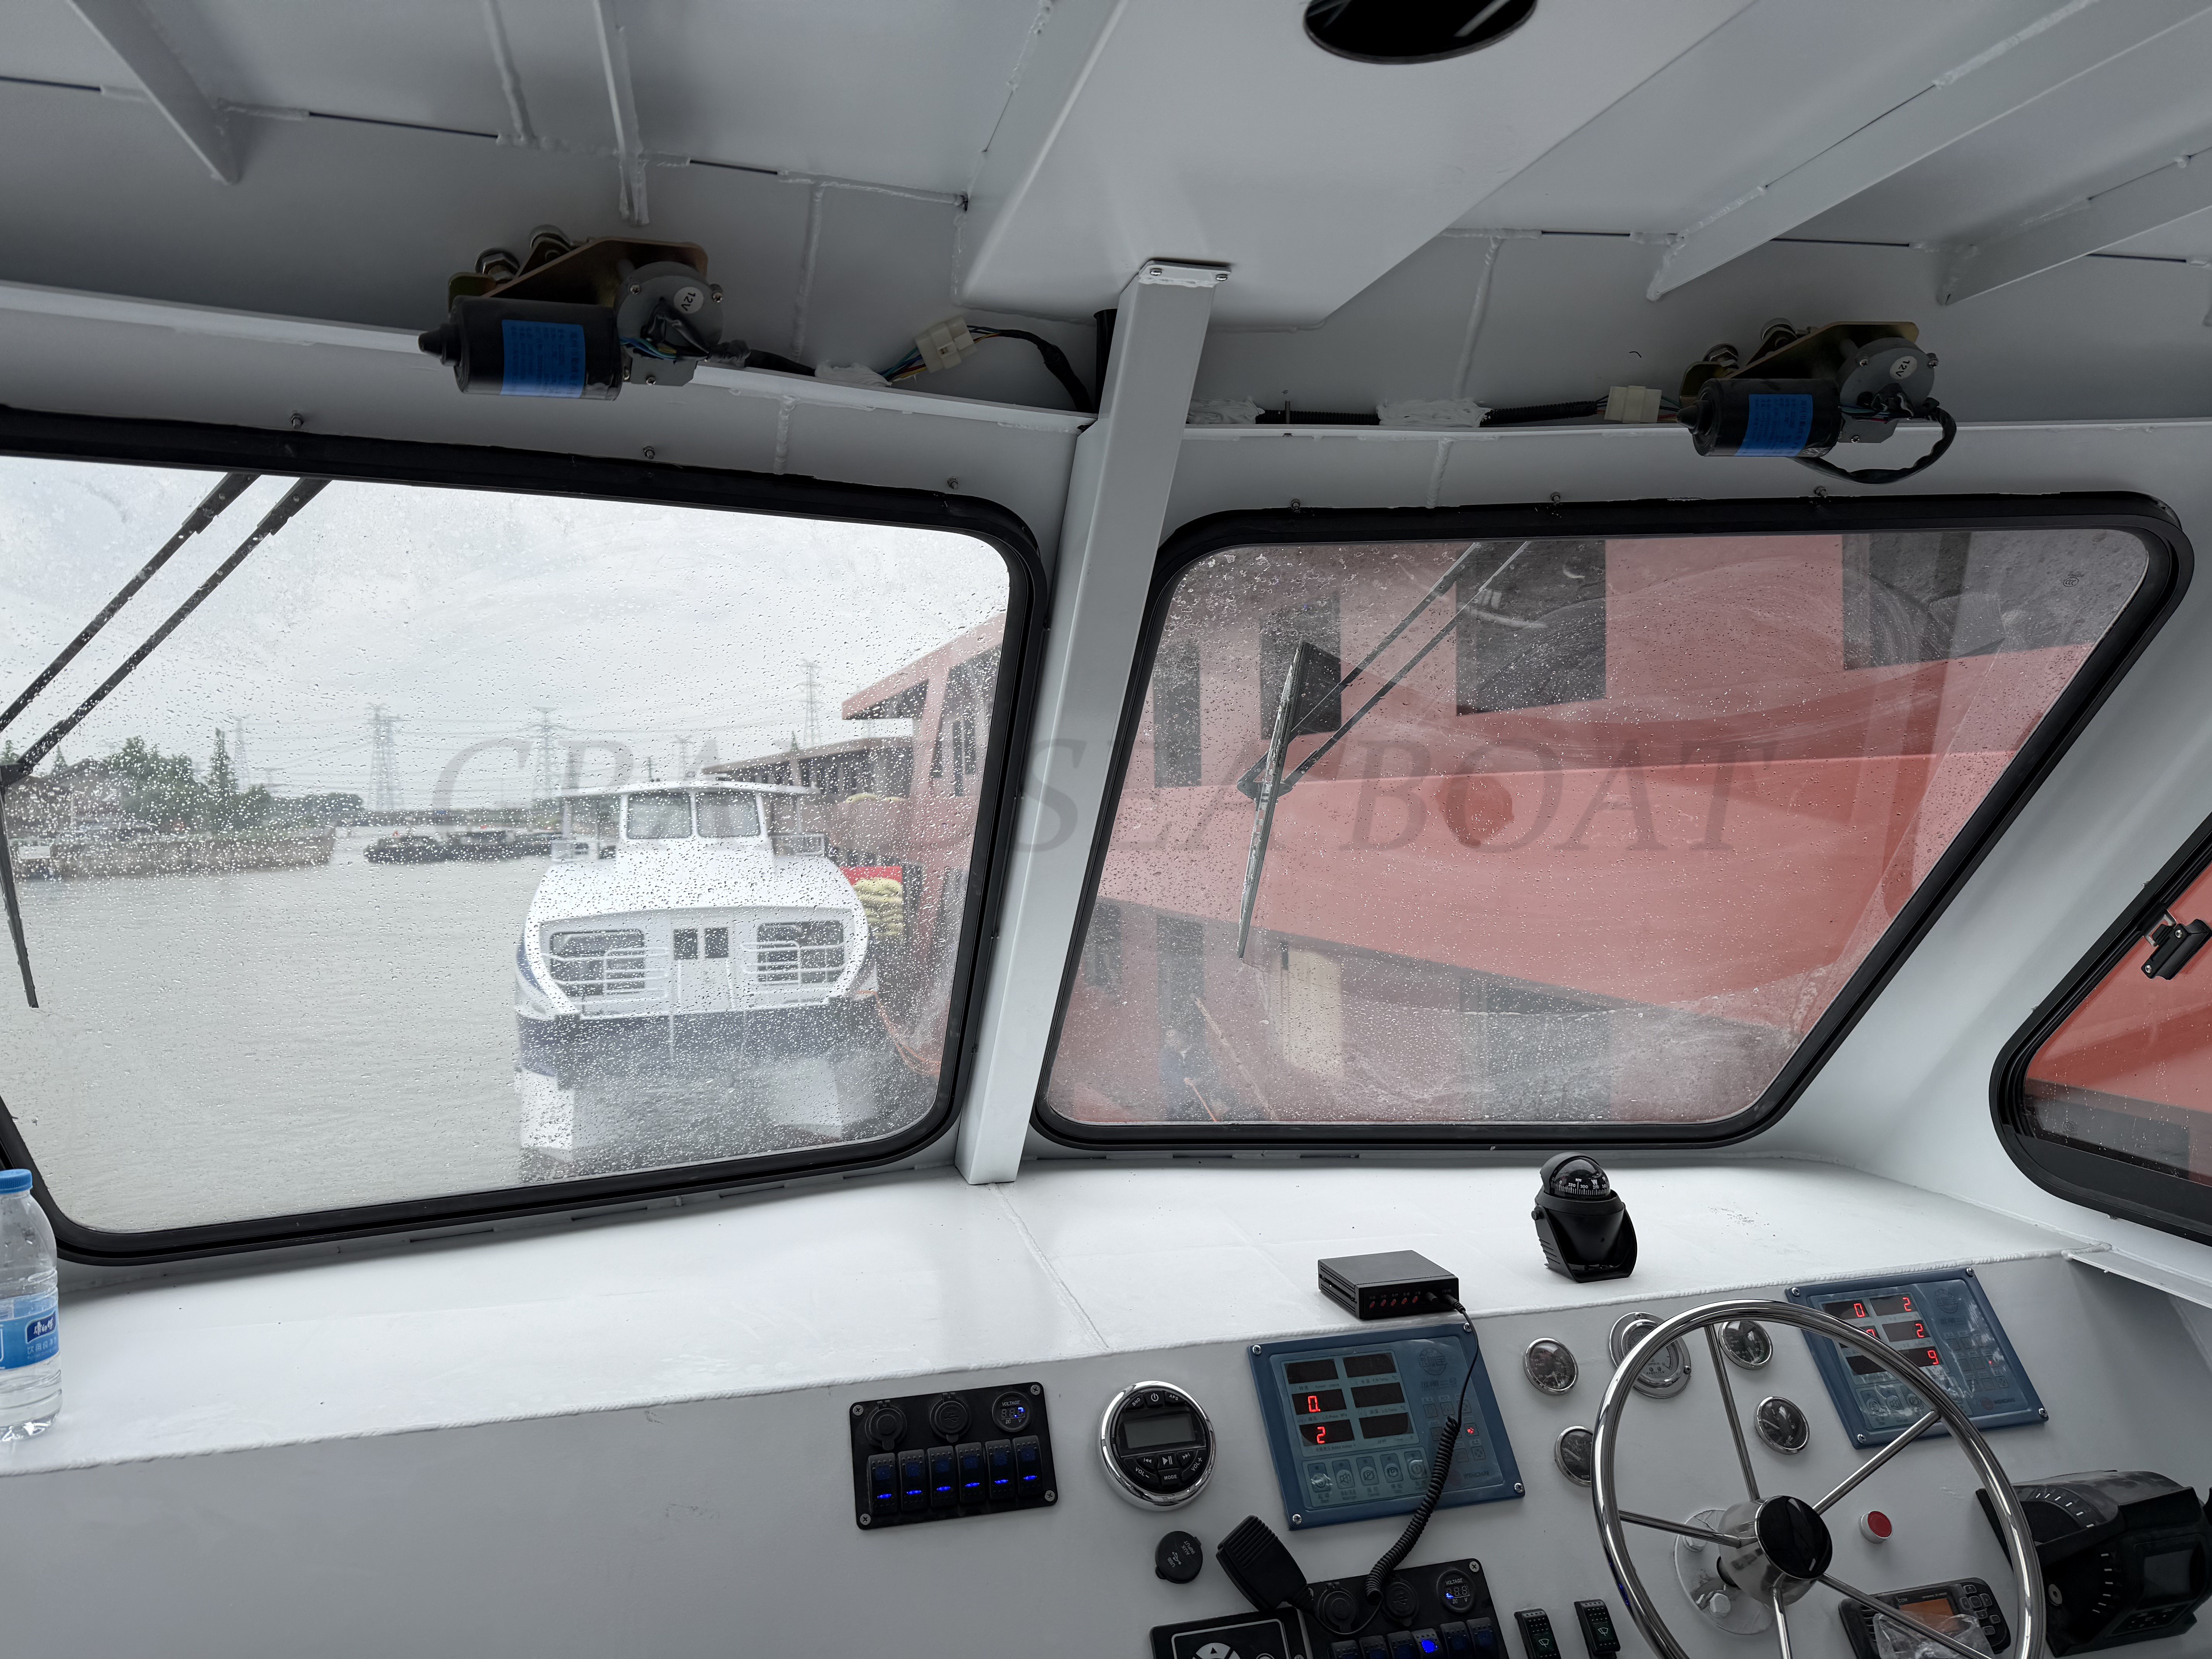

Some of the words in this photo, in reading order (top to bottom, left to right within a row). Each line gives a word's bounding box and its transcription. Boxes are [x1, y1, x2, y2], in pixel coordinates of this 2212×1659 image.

[681, 292, 696, 311] 12V
[1896, 360, 1910, 377] 12V
[1853, 1303, 1865, 1318] 0
[1903, 1297, 1912, 1312] 2
[1915, 1322, 1925, 1338] 2
[1927, 1350, 1940, 1365] 9
[1132, 1398, 1141, 1407] BND
[1316, 1426, 1326, 1444] 2
[1181, 1544, 1190, 1555] AUX
[1183, 1540, 1195, 1554] INPUT
[1167, 1557, 1175, 1568] USB
